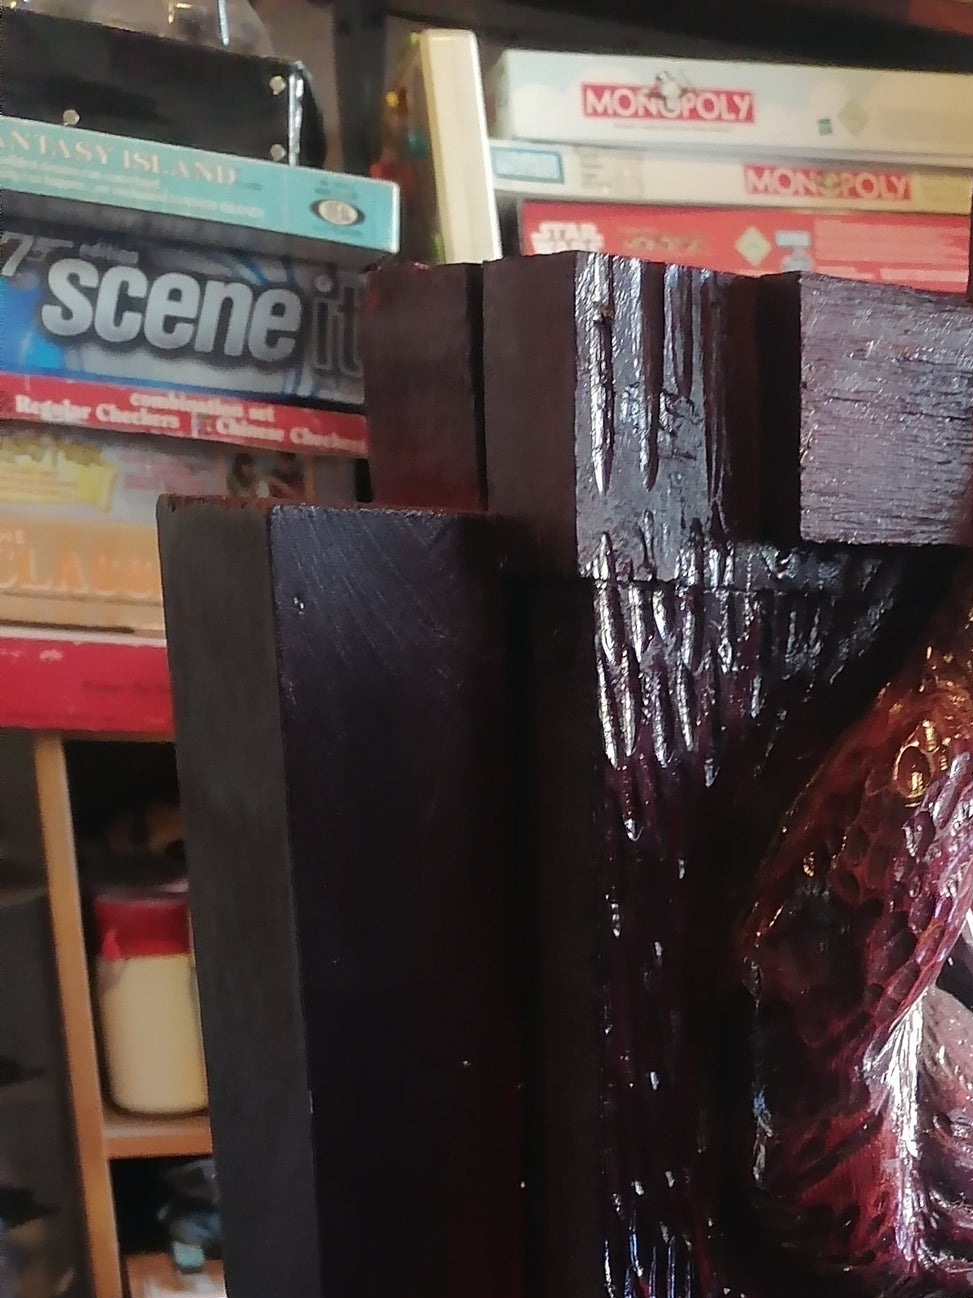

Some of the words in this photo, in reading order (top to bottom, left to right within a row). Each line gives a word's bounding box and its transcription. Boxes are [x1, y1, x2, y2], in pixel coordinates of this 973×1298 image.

[585, 88, 751, 121] MONOPOLY
[122, 149, 239, 186] ISLAND
[746, 167, 910, 200] MONOPOLY
[42, 258, 301, 362] scene
[310, 274, 363, 378] it
